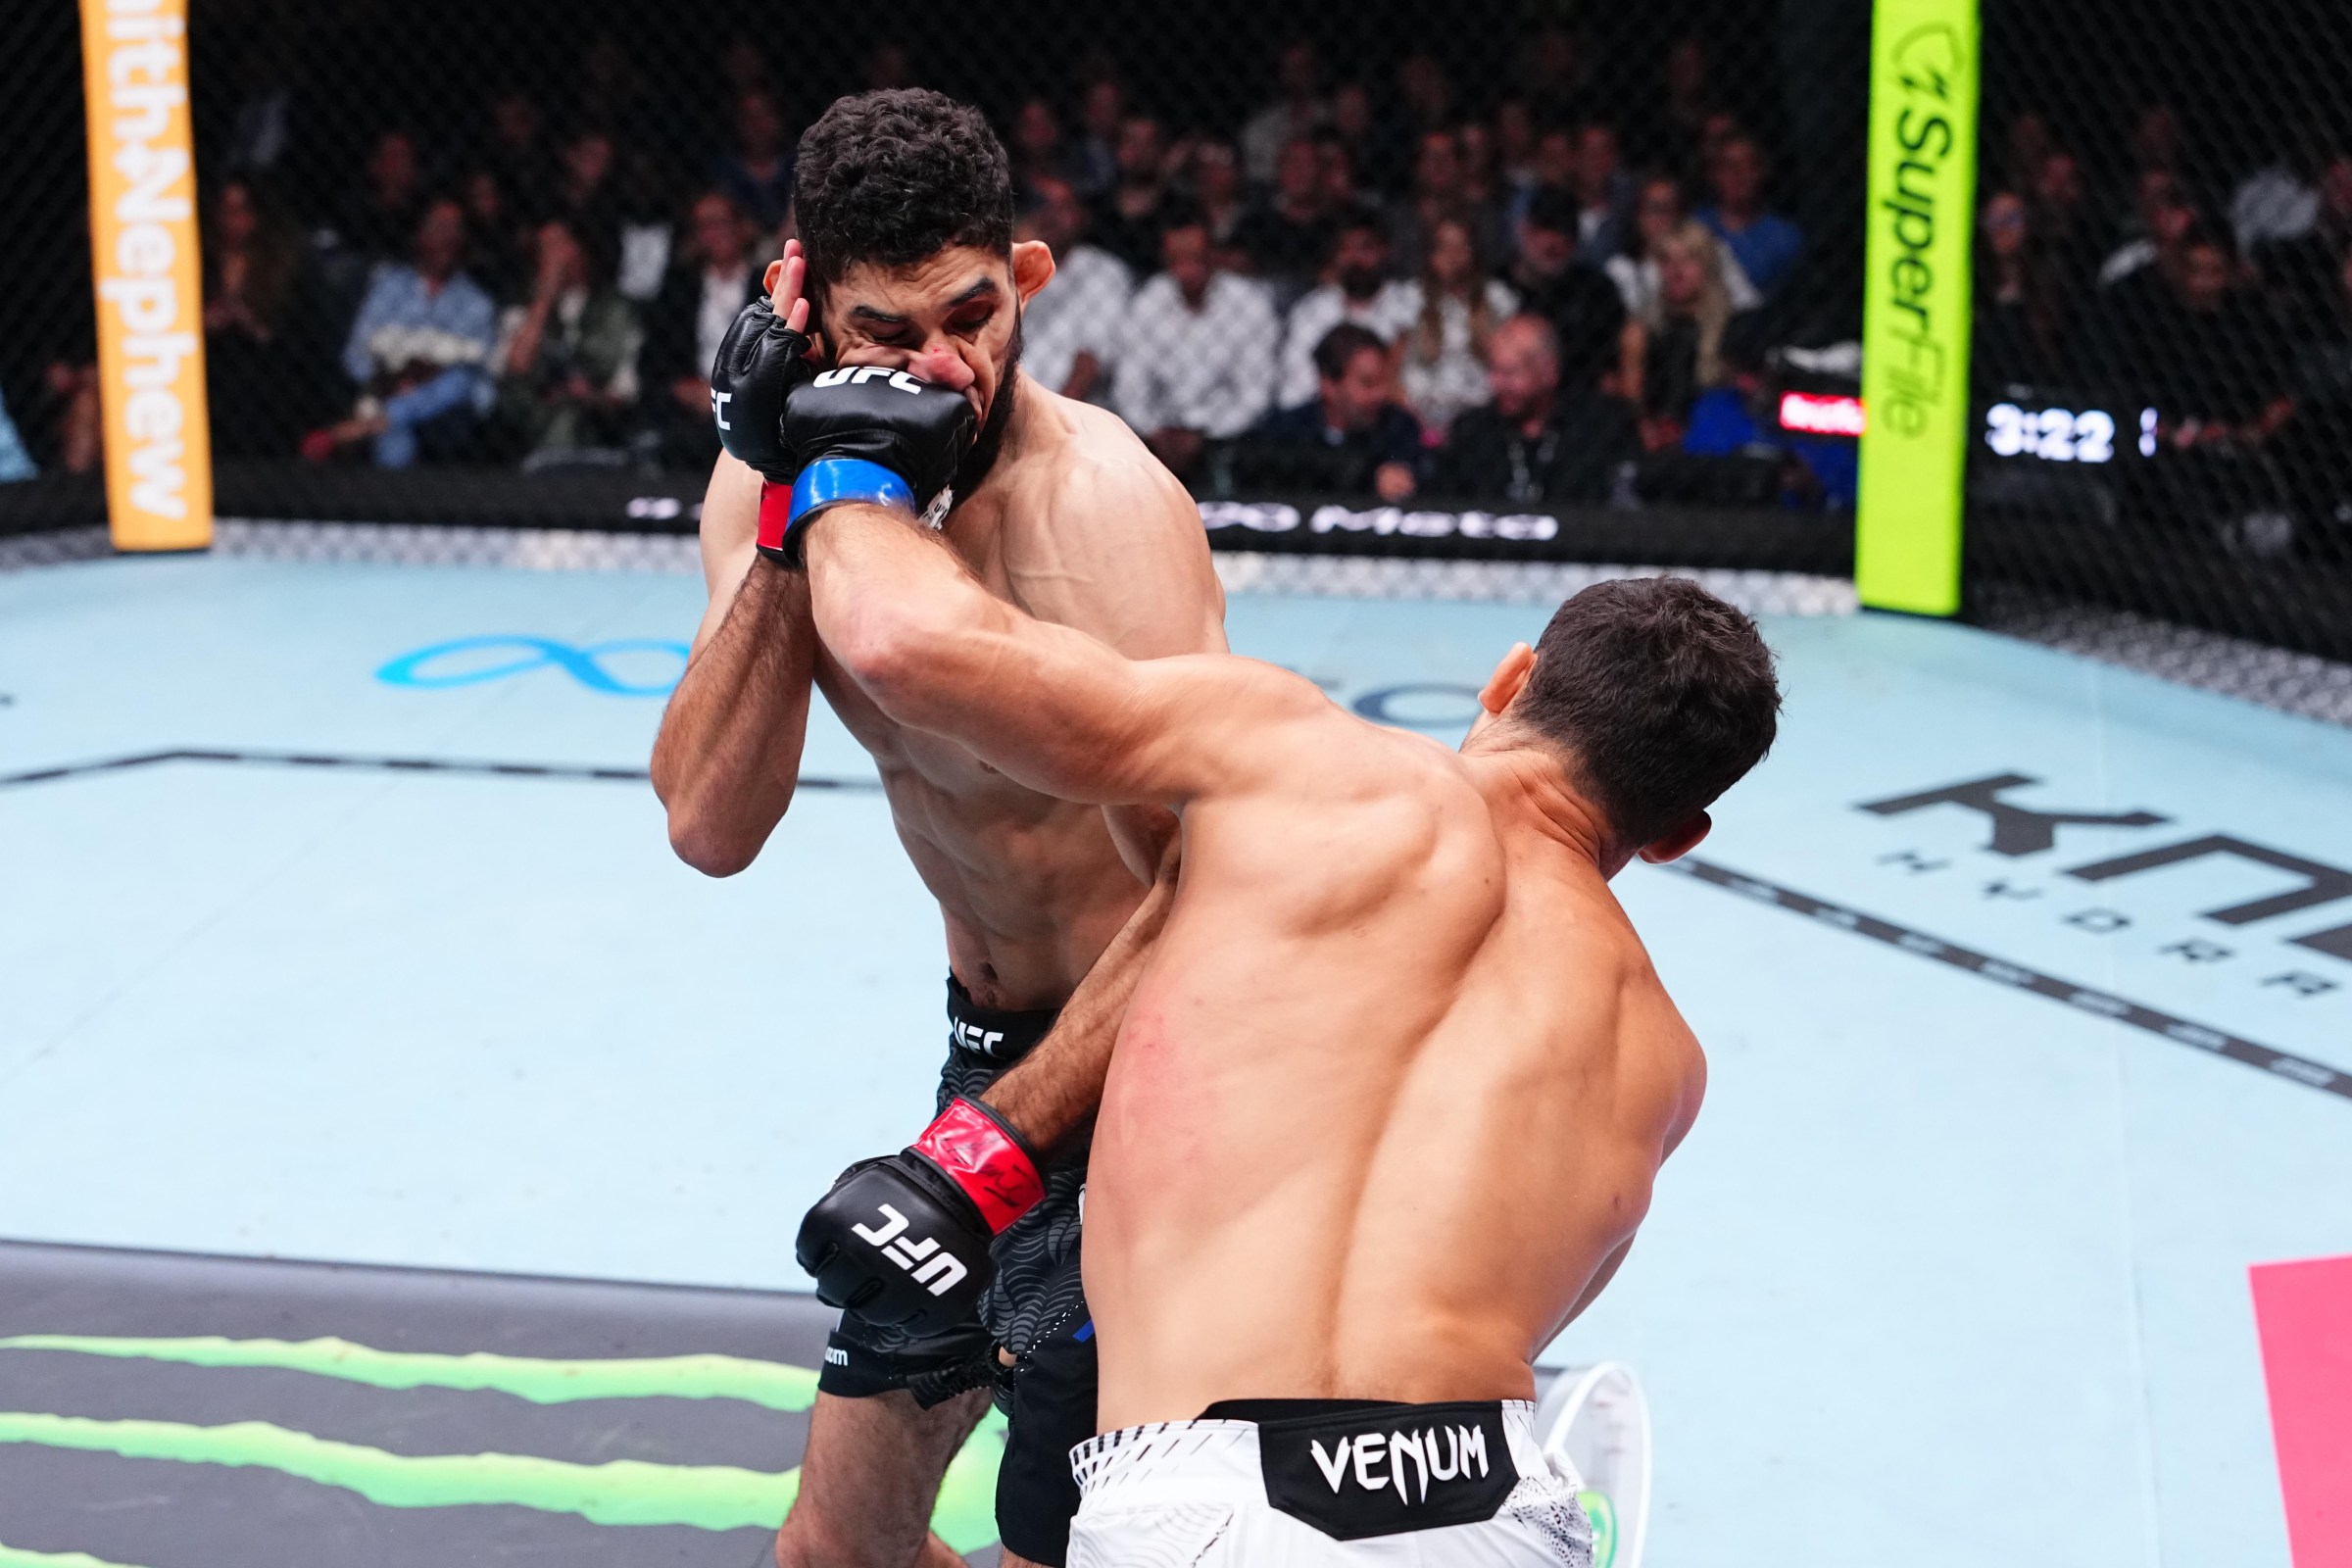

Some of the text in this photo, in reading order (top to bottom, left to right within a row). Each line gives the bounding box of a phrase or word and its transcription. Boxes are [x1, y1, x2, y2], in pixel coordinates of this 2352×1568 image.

[1881, 110, 1952, 439] SuperFile
[812, 366, 929, 395] UFC
[1984, 403, 2115, 463] 3:22
[954, 1015, 1004, 1058] UFC
[851, 1203, 968, 1297] UFC
[1310, 1424, 1490, 1506] VENUM
